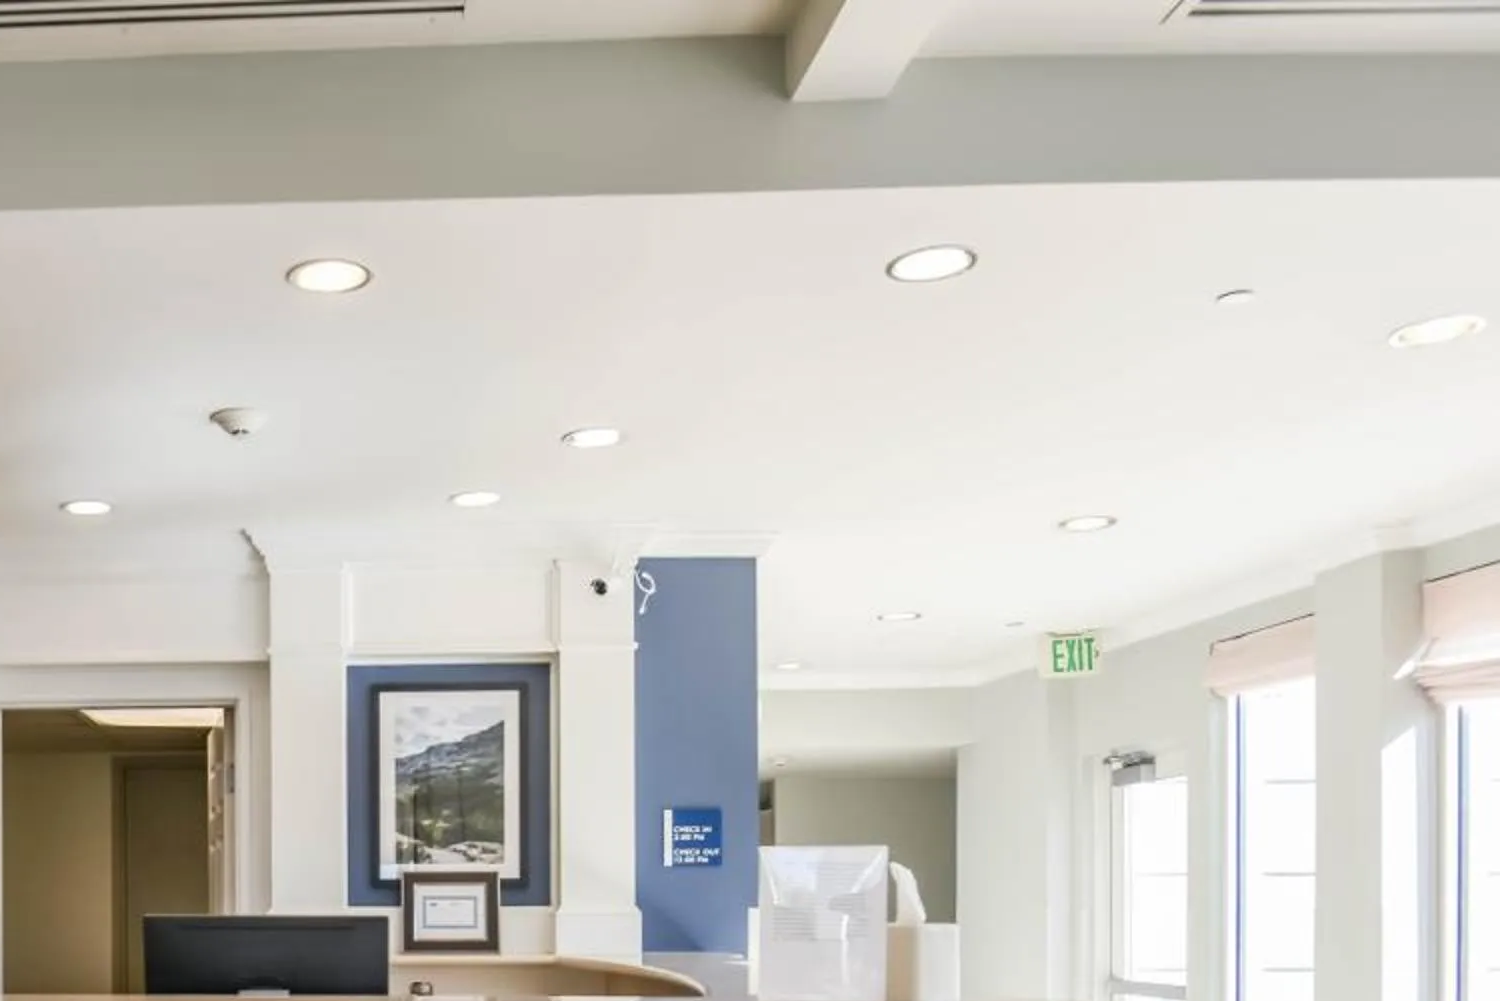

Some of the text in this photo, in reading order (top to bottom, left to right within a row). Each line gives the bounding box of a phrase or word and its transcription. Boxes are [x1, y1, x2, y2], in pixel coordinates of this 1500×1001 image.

[1051, 637, 1095, 673] EXIT
[673, 825, 700, 833] CHECK
[673, 847, 721, 856] CHECK OUT
